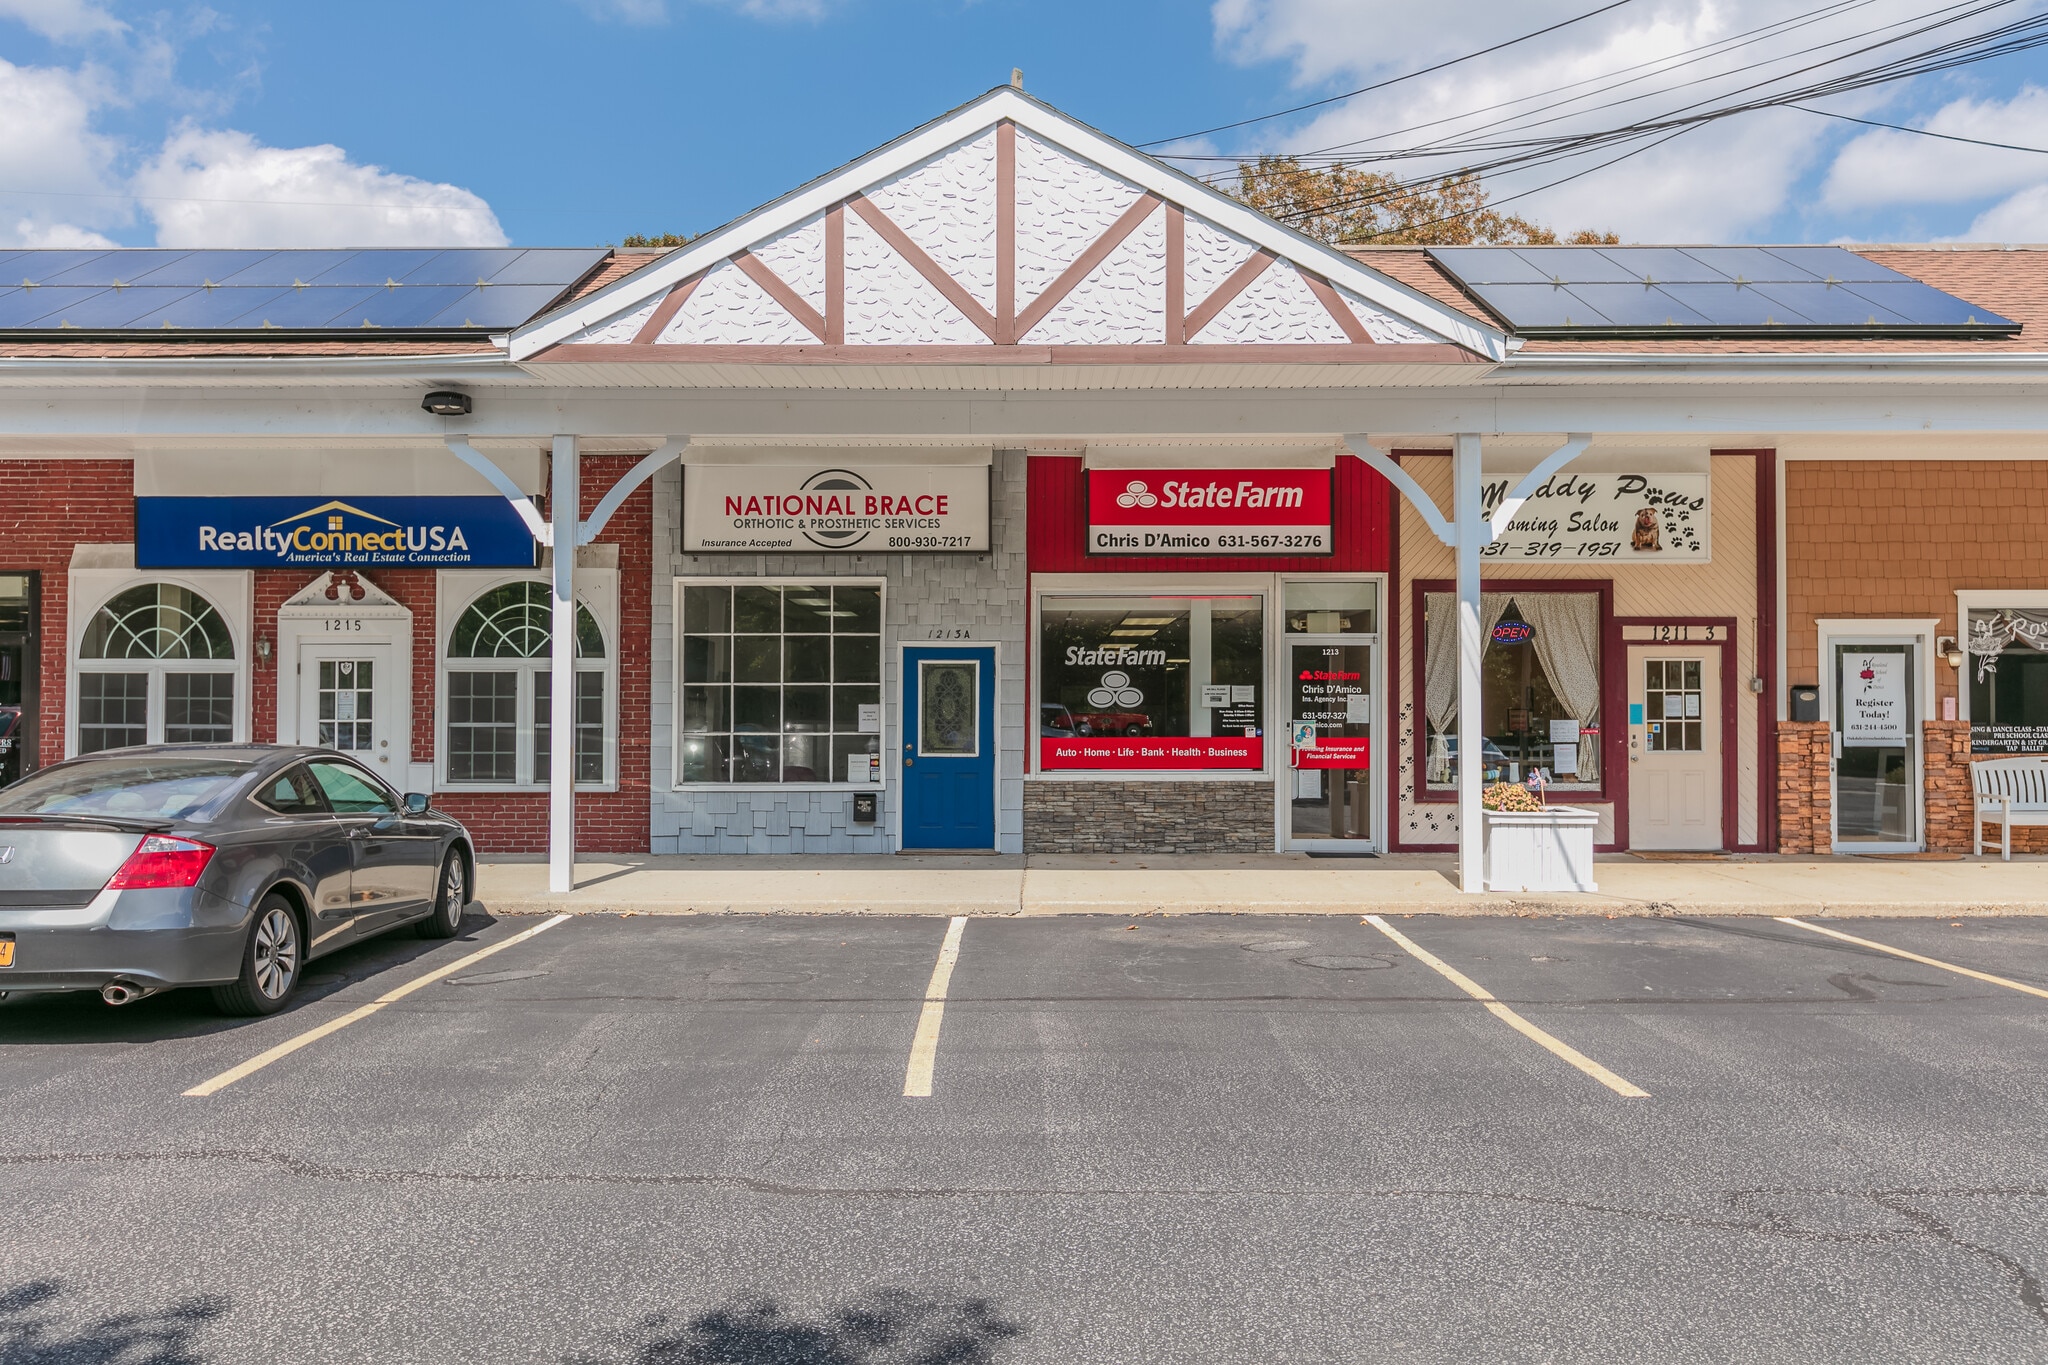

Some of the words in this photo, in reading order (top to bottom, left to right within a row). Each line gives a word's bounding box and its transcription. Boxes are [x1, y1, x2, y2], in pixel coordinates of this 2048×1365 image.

[1481, 474, 1596, 509] Mddy
[725, 495, 856, 516] NATIONAL
[865, 495, 948, 516] BRACE
[733, 518, 794, 529] ORTHOTIC
[798, 518, 806, 529] &
[810, 518, 881, 529] PROSTHETIC
[884, 518, 941, 529] SERVICES
[1481, 510, 1559, 539] oming
[1566, 511, 1619, 533] Salon
[199, 525, 469, 557] RealtyConnectUSA
[701, 539, 747, 547] Insurance
[749, 539, 793, 549] Accepted
[888, 536, 972, 547] 800-930-7217
[1096, 533, 1139, 547] Chris
[1144, 533, 1210, 547] D'Amico
[1217, 534, 1322, 547] 631-567-3276
[286, 552, 341, 562] America's
[344, 552, 369, 562] Real
[372, 552, 405, 562] Estate
[408, 552, 471, 562] Connection
[325, 619, 361, 631] 1215
[928, 629, 970, 639] 1213A
[1492, 627, 1531, 638] OPEN
[1653, 625, 1688, 640] 1211
[1705, 625, 1715, 640] 3
[1322, 648, 1340, 656] 1213
[1302, 685, 1325, 694] Chris
[1326, 685, 1362, 694] D'Amico
[1314, 696, 1336, 704] Agency
[1855, 699, 1894, 708] Register
[1859, 711, 1890, 720] Today!
[1055, 747, 1077, 757] Auto
[1084, 747, 1111, 757] Home
[1117, 747, 1135, 757] Life
[1141, 747, 1165, 757] Bank
[1171, 747, 1201, 757] Health
[1208, 747, 1248, 757] Business
